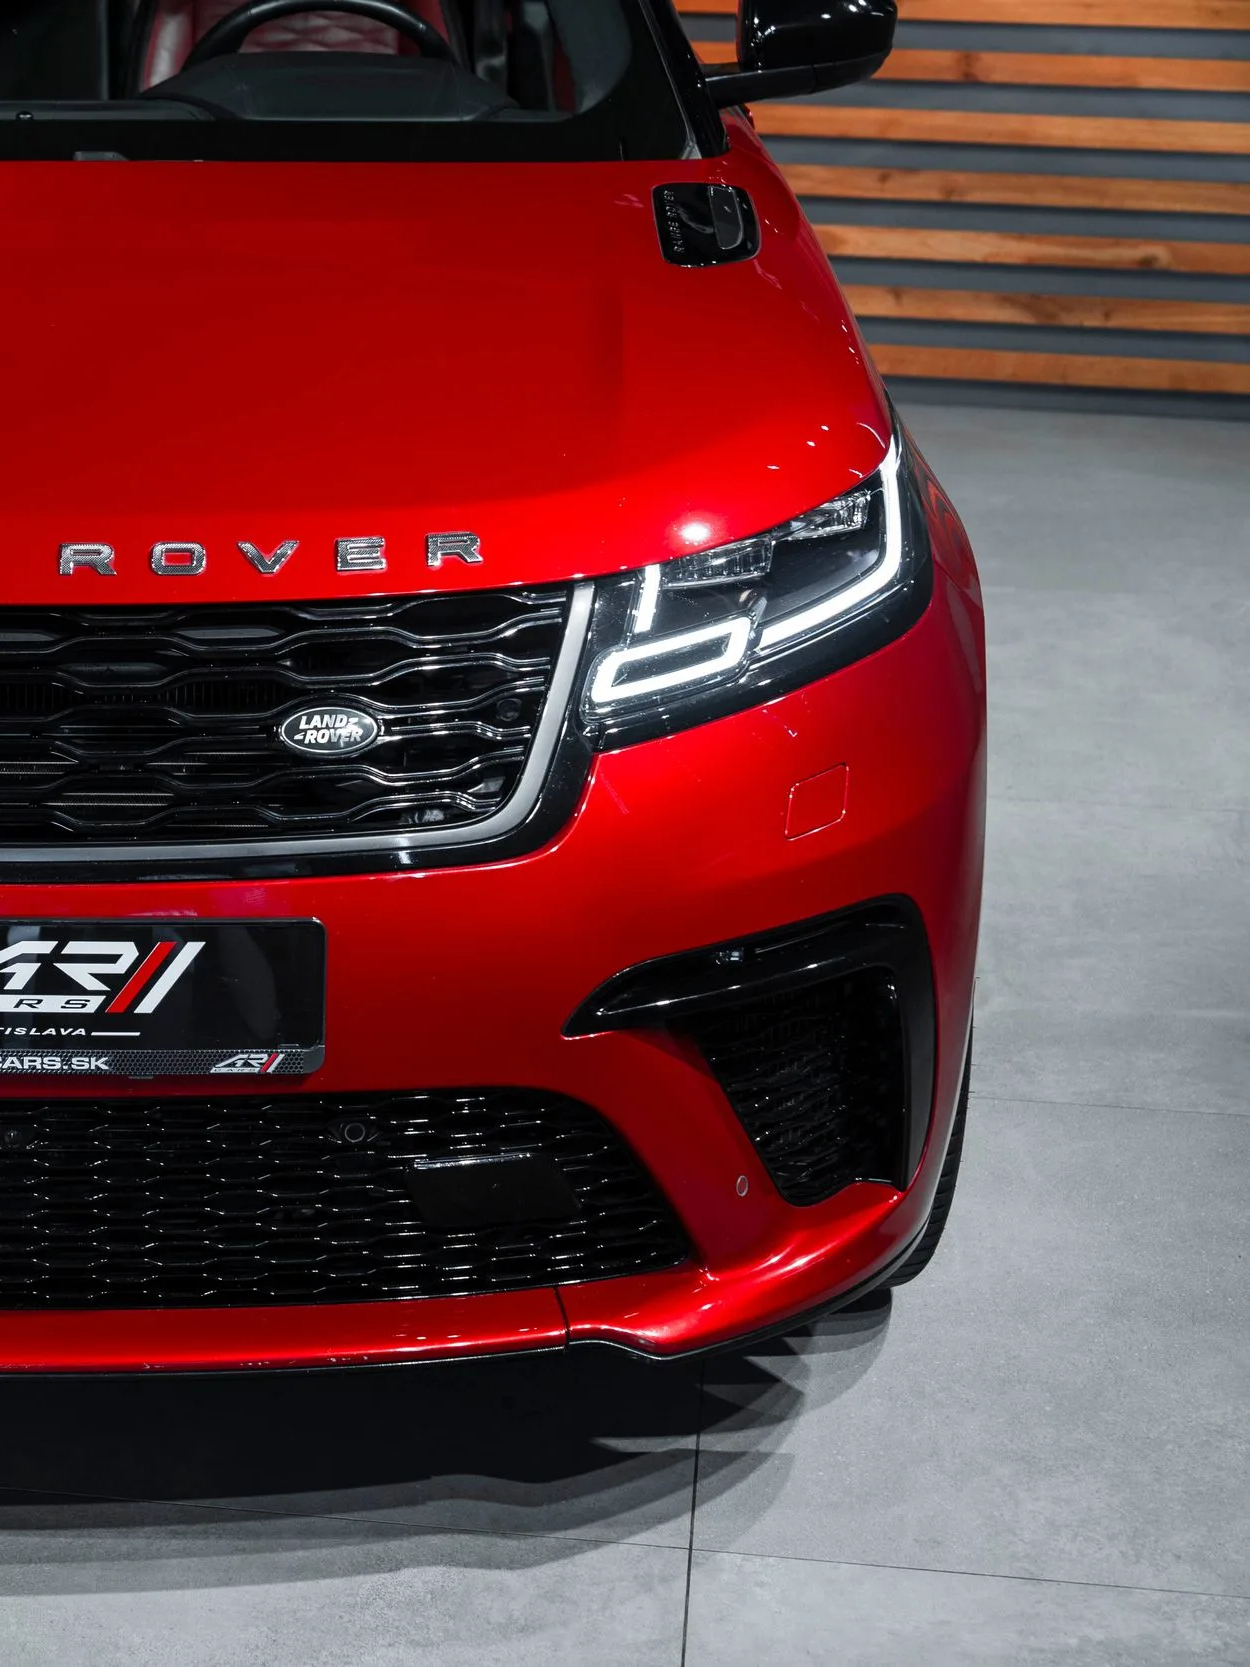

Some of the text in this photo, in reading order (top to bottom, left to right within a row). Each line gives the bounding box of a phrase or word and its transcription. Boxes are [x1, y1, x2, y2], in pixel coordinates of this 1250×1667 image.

[58, 531, 483, 578] ROVER
[299, 715, 348, 730] LAND
[304, 728, 364, 744] ROVER
